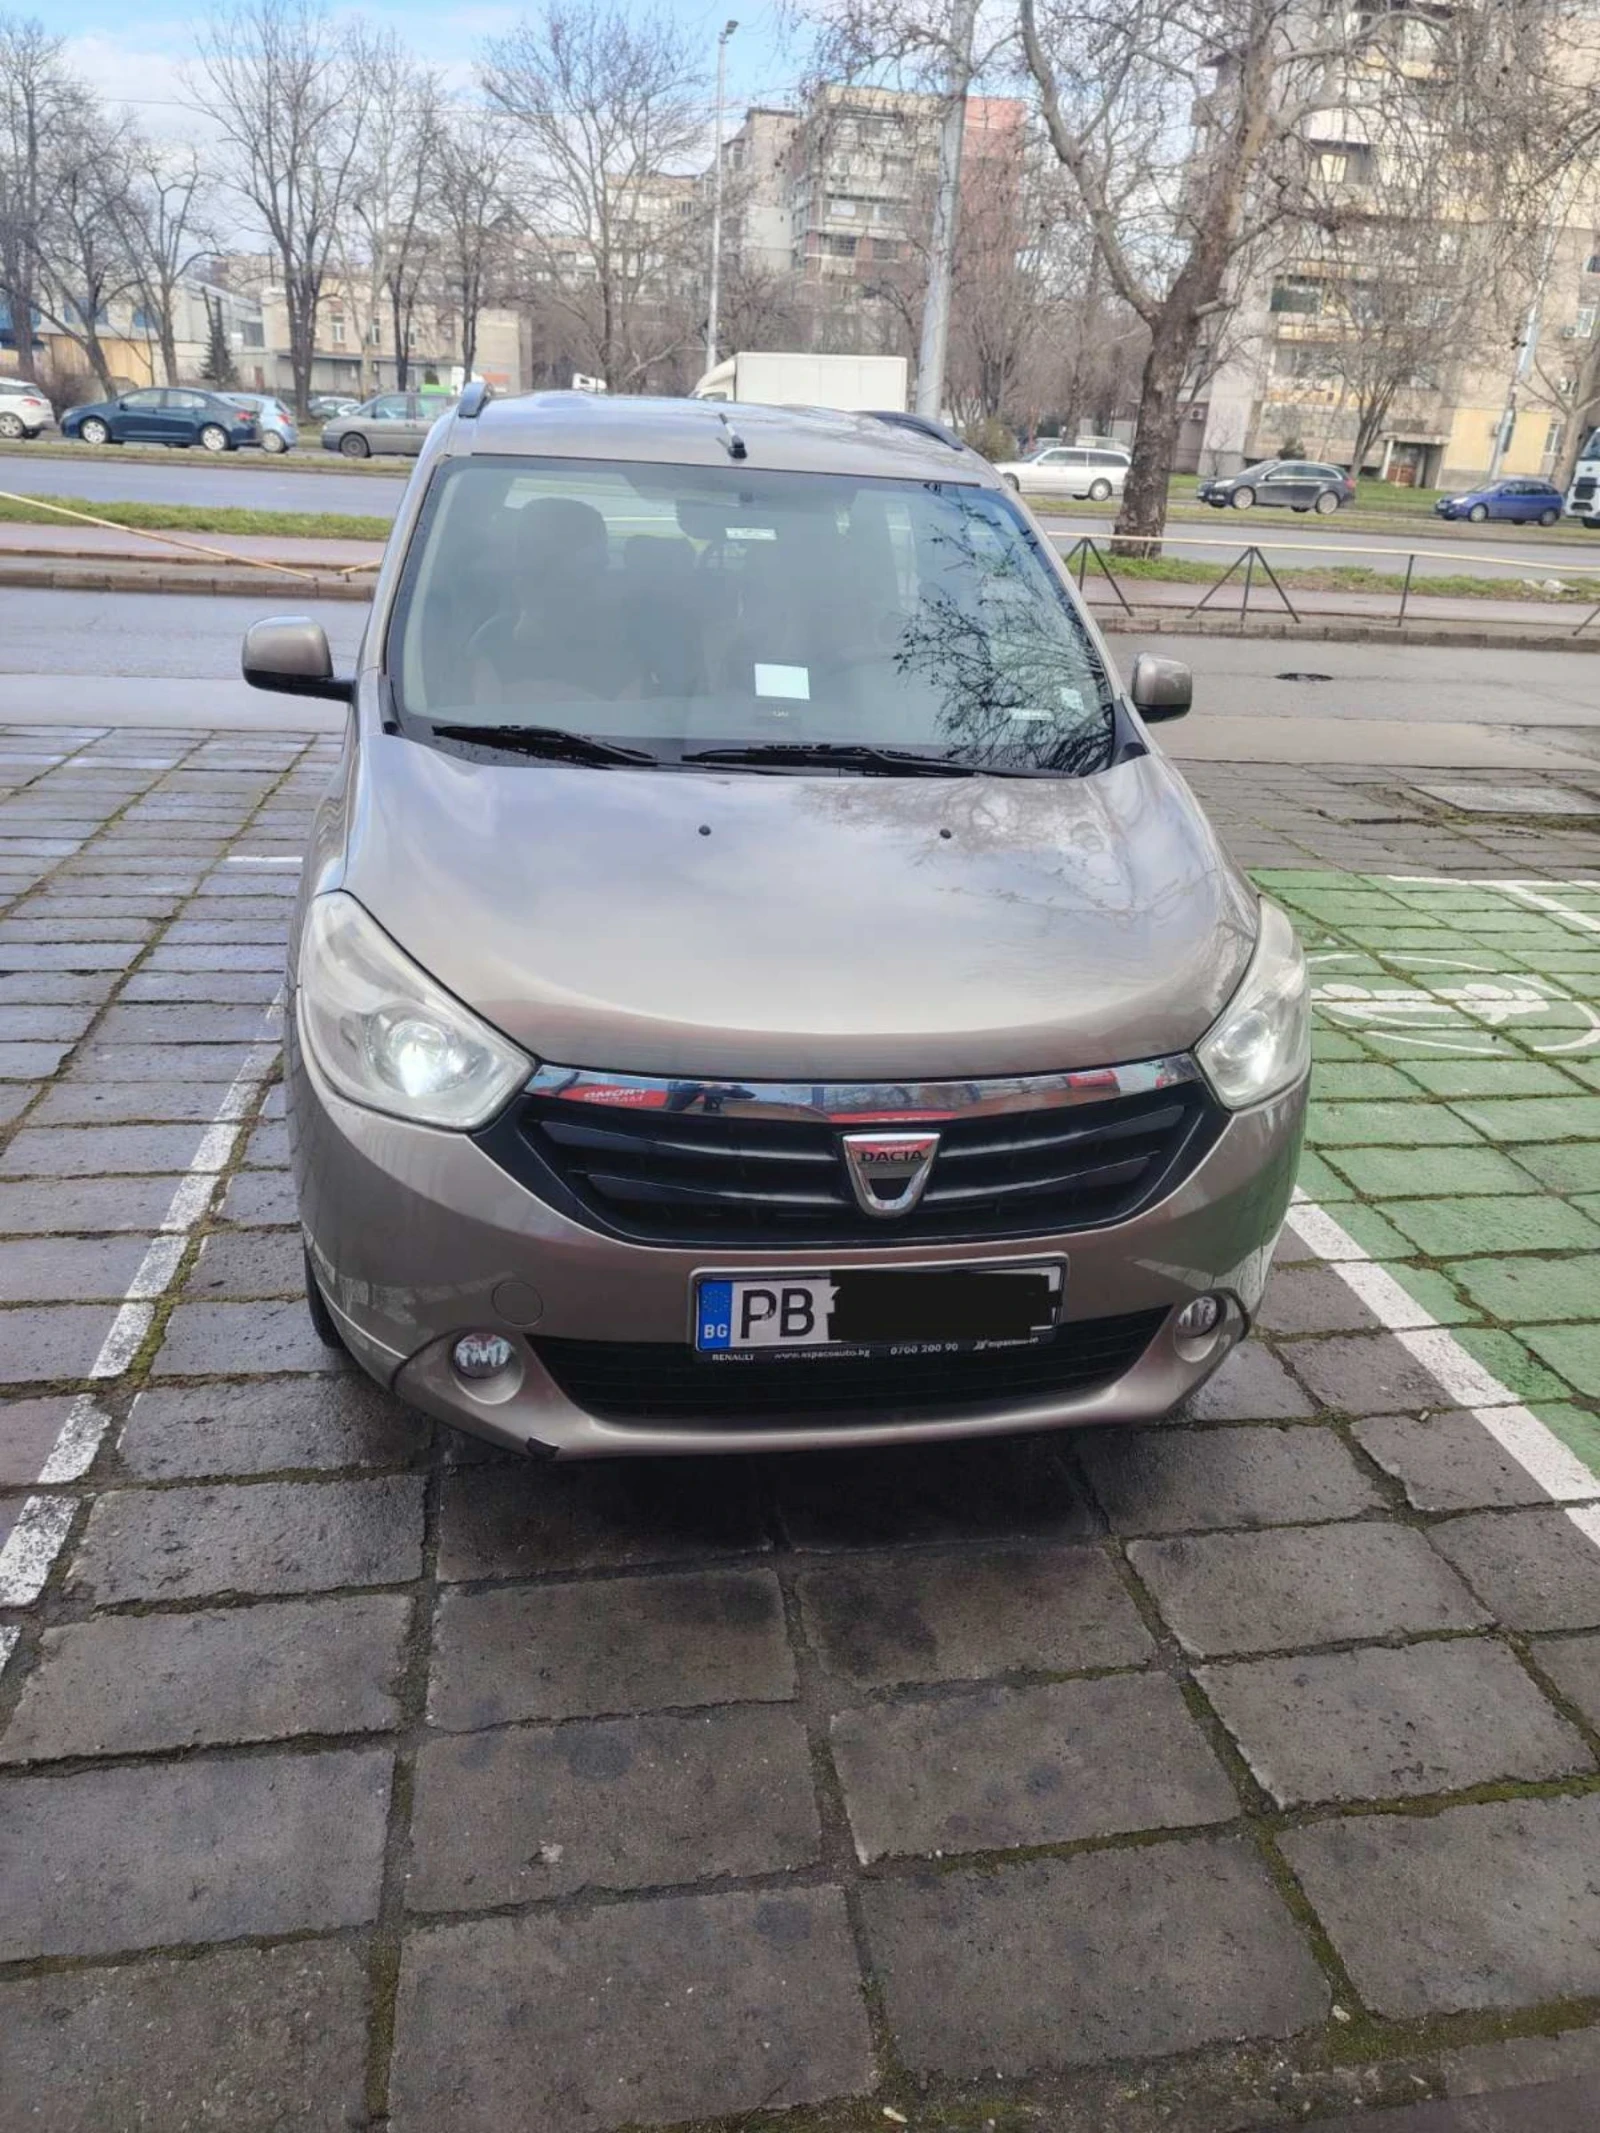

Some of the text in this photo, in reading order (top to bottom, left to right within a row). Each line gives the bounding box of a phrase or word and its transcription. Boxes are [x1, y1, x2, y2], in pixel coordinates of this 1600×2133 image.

[861, 1150, 922, 1161] DACIA
[703, 1324, 728, 1339] BG
[921, 1344, 942, 1354] 200
